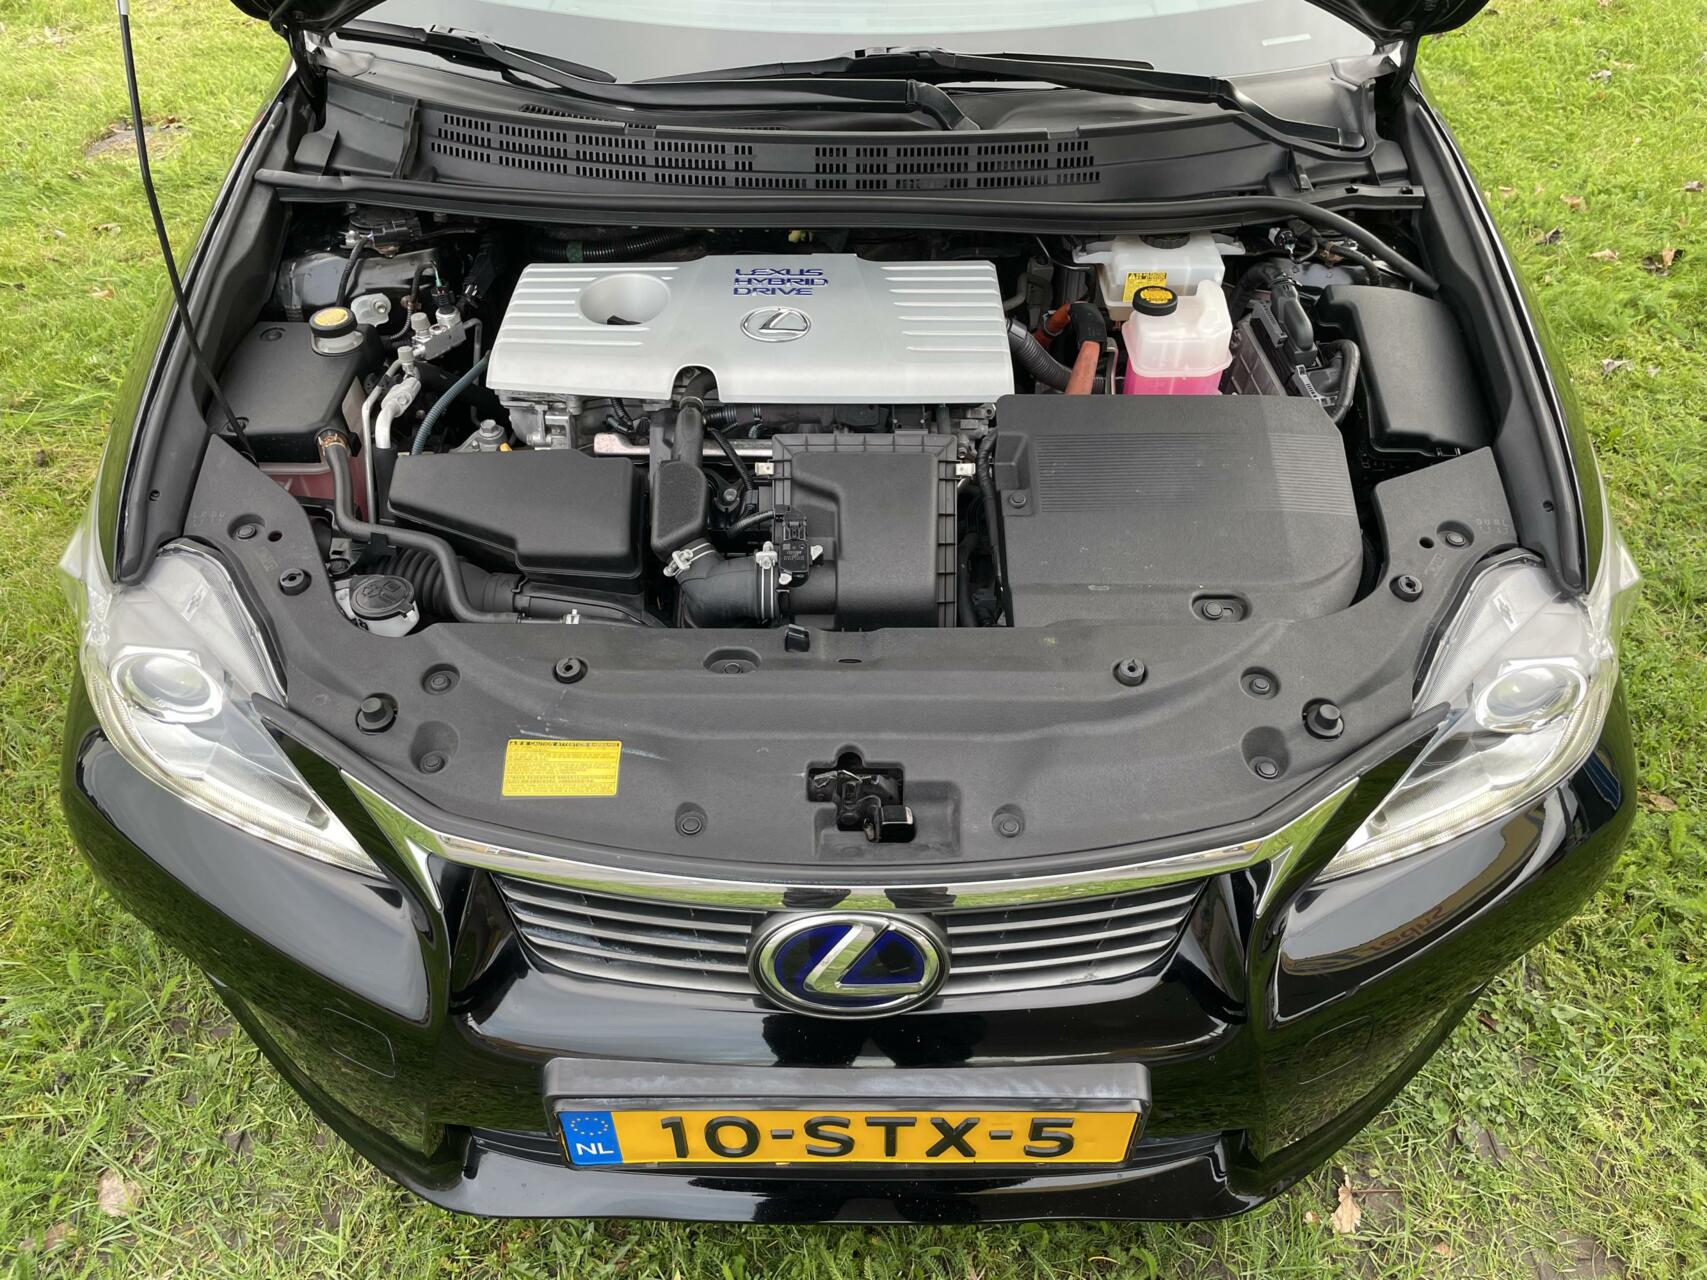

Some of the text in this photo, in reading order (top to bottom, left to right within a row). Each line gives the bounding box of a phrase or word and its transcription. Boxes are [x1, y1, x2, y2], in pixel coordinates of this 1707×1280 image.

[735, 267, 824, 276] LEXUS
[733, 277, 829, 286] HYBRID
[733, 287, 814, 295] DRIVE
[575, 1115, 1075, 1158] NL 10-STX-5
